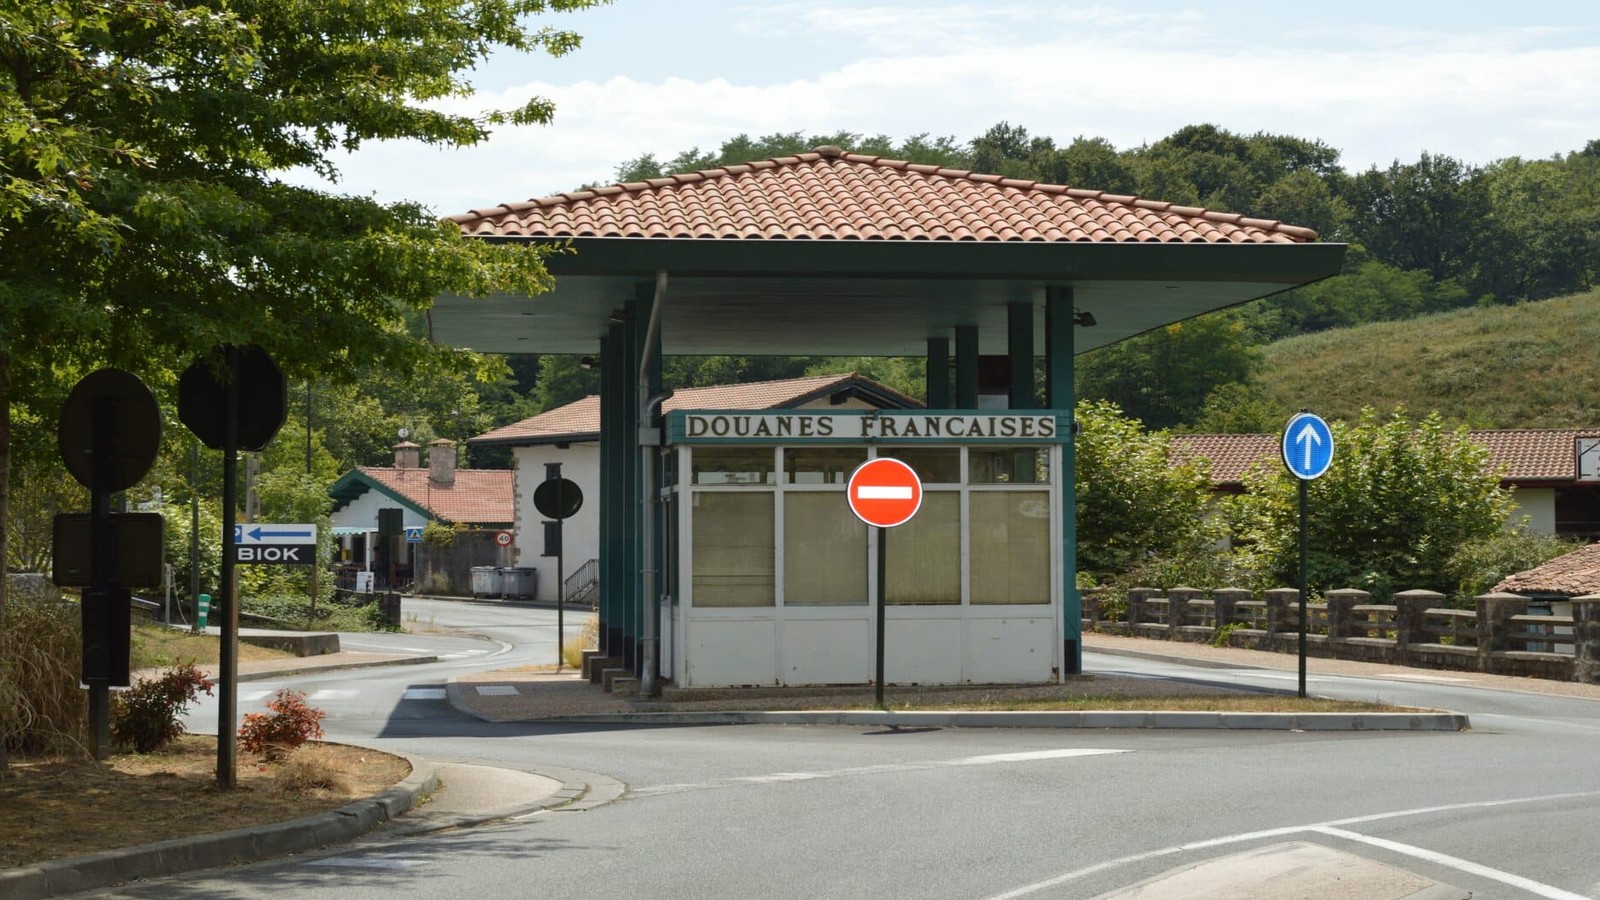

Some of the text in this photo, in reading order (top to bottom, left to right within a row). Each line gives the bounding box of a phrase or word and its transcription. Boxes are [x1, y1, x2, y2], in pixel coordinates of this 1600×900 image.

[688, 416, 1055, 437] DOUANES FRANCAISES
[238, 548, 299, 561] BIOK
